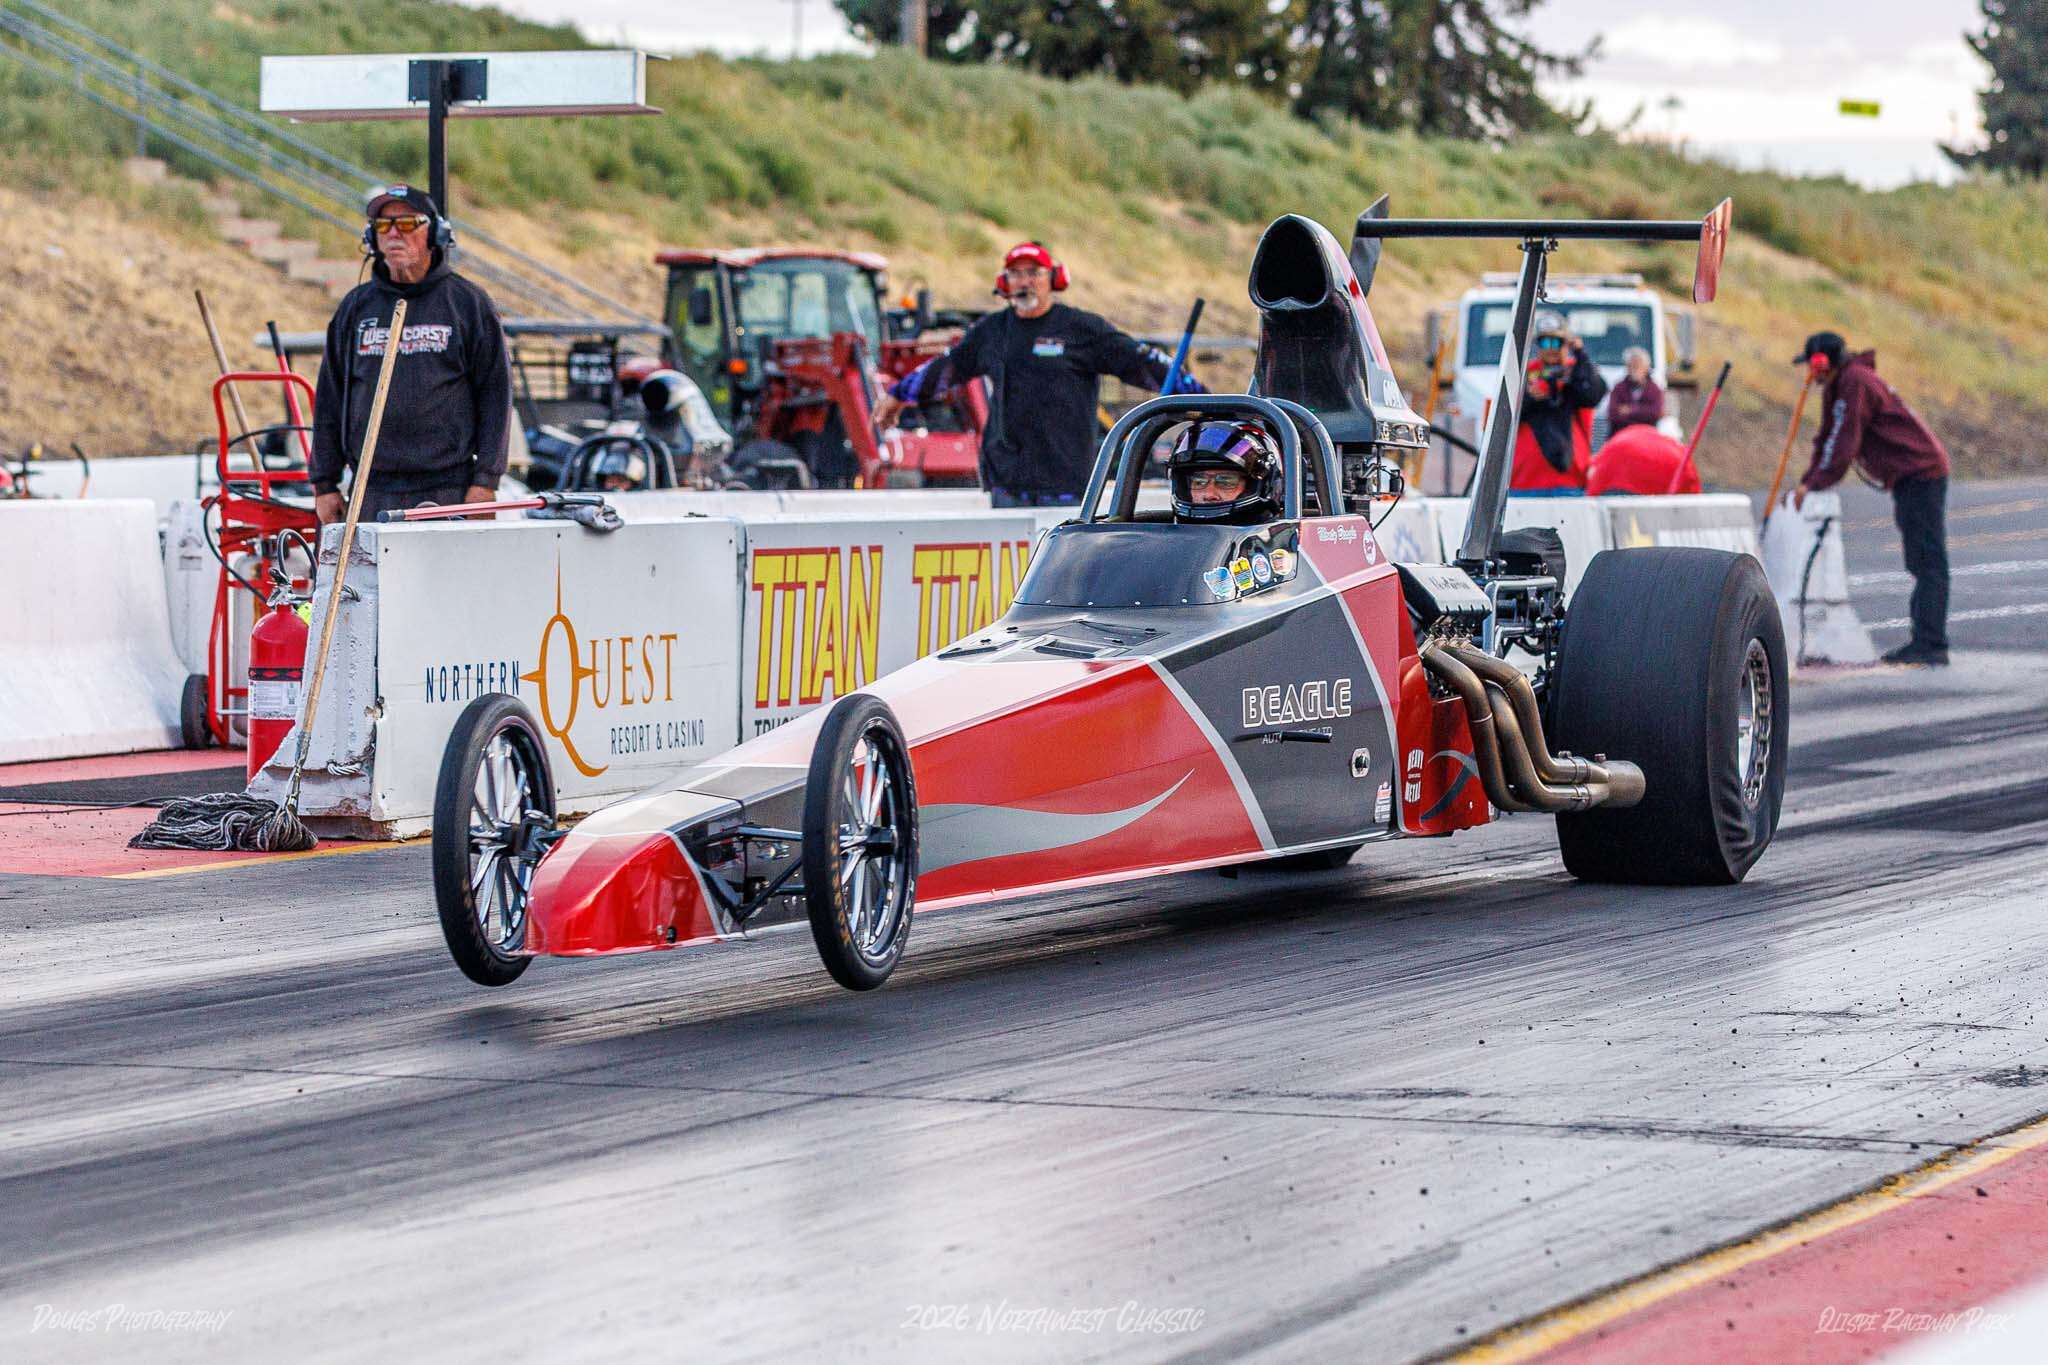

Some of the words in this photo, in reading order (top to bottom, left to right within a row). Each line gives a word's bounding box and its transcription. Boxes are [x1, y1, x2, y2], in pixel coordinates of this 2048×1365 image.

[362, 326, 391, 345] WES
[402, 324, 452, 343] COAST
[752, 545, 884, 709] TITAN
[425, 660, 520, 704] NORTHERN
[529, 598, 678, 778] QUEST
[1242, 678, 1352, 729] BEAGLE
[611, 725, 651, 755] RESORT
[656, 723, 663, 750] &
[667, 719, 705, 749] CASINO
